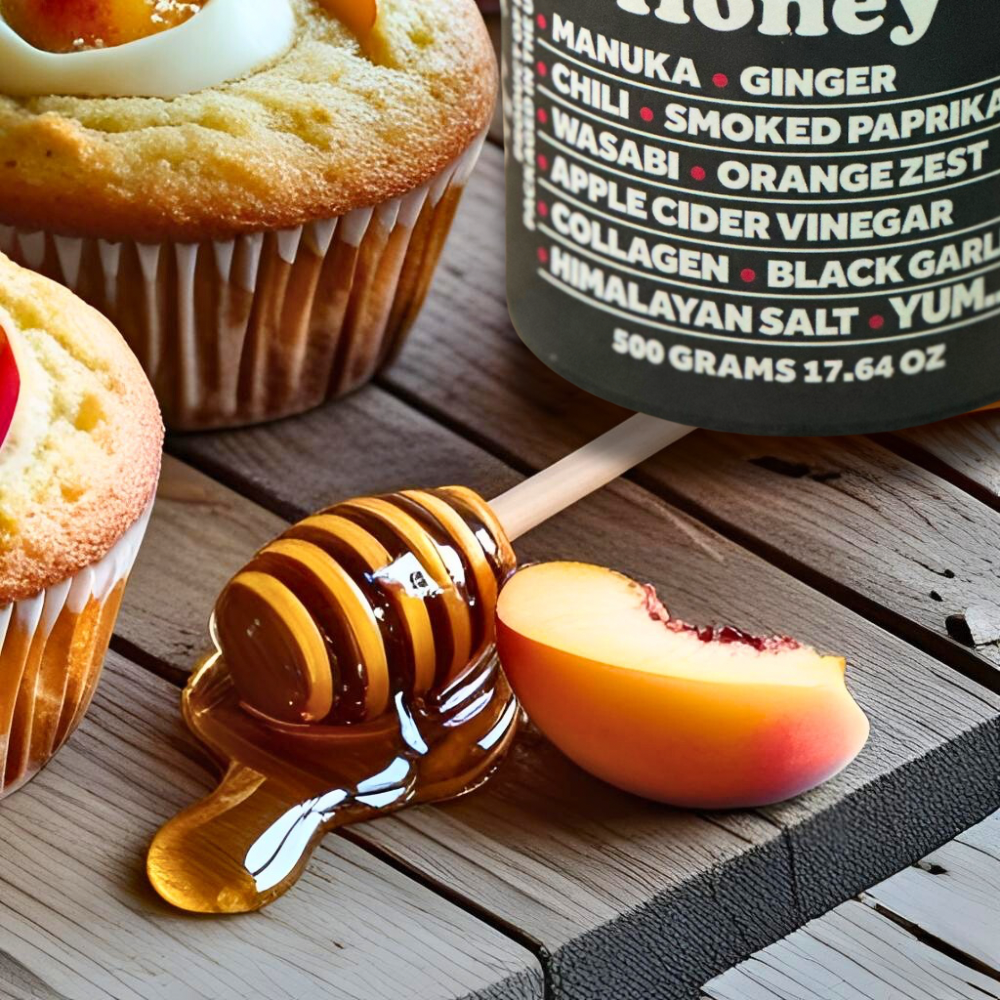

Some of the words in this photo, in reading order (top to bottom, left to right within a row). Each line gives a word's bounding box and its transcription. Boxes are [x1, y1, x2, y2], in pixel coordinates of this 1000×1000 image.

[522, 15, 534, 64] THE
[523, 66, 535, 95] IN
[551, 12, 701, 88] MANUKA
[740, 64, 897, 98] GINGER
[551, 62, 630, 120] CHILI
[664, 103, 841, 146] SMOKED
[550, 107, 680, 181] WASABI
[717, 158, 894, 193] ORANGE
[899, 140, 989, 186] ZEST
[550, 154, 647, 220] APPLE
[652, 196, 770, 240] CIDER
[775, 199, 954, 241] VINEGAR
[551, 201, 729, 284] COLLAGEN
[767, 255, 903, 289] BLACK
[908, 229, 1000, 279] GARL
[550, 246, 752, 334] HIMALAYAN
[759, 306, 859, 337] SALT
[612, 328, 664, 365] 500
[668, 342, 796, 384] GRAMS
[803, 354, 894, 383] 17.64
[899, 343, 946, 375] OZ
